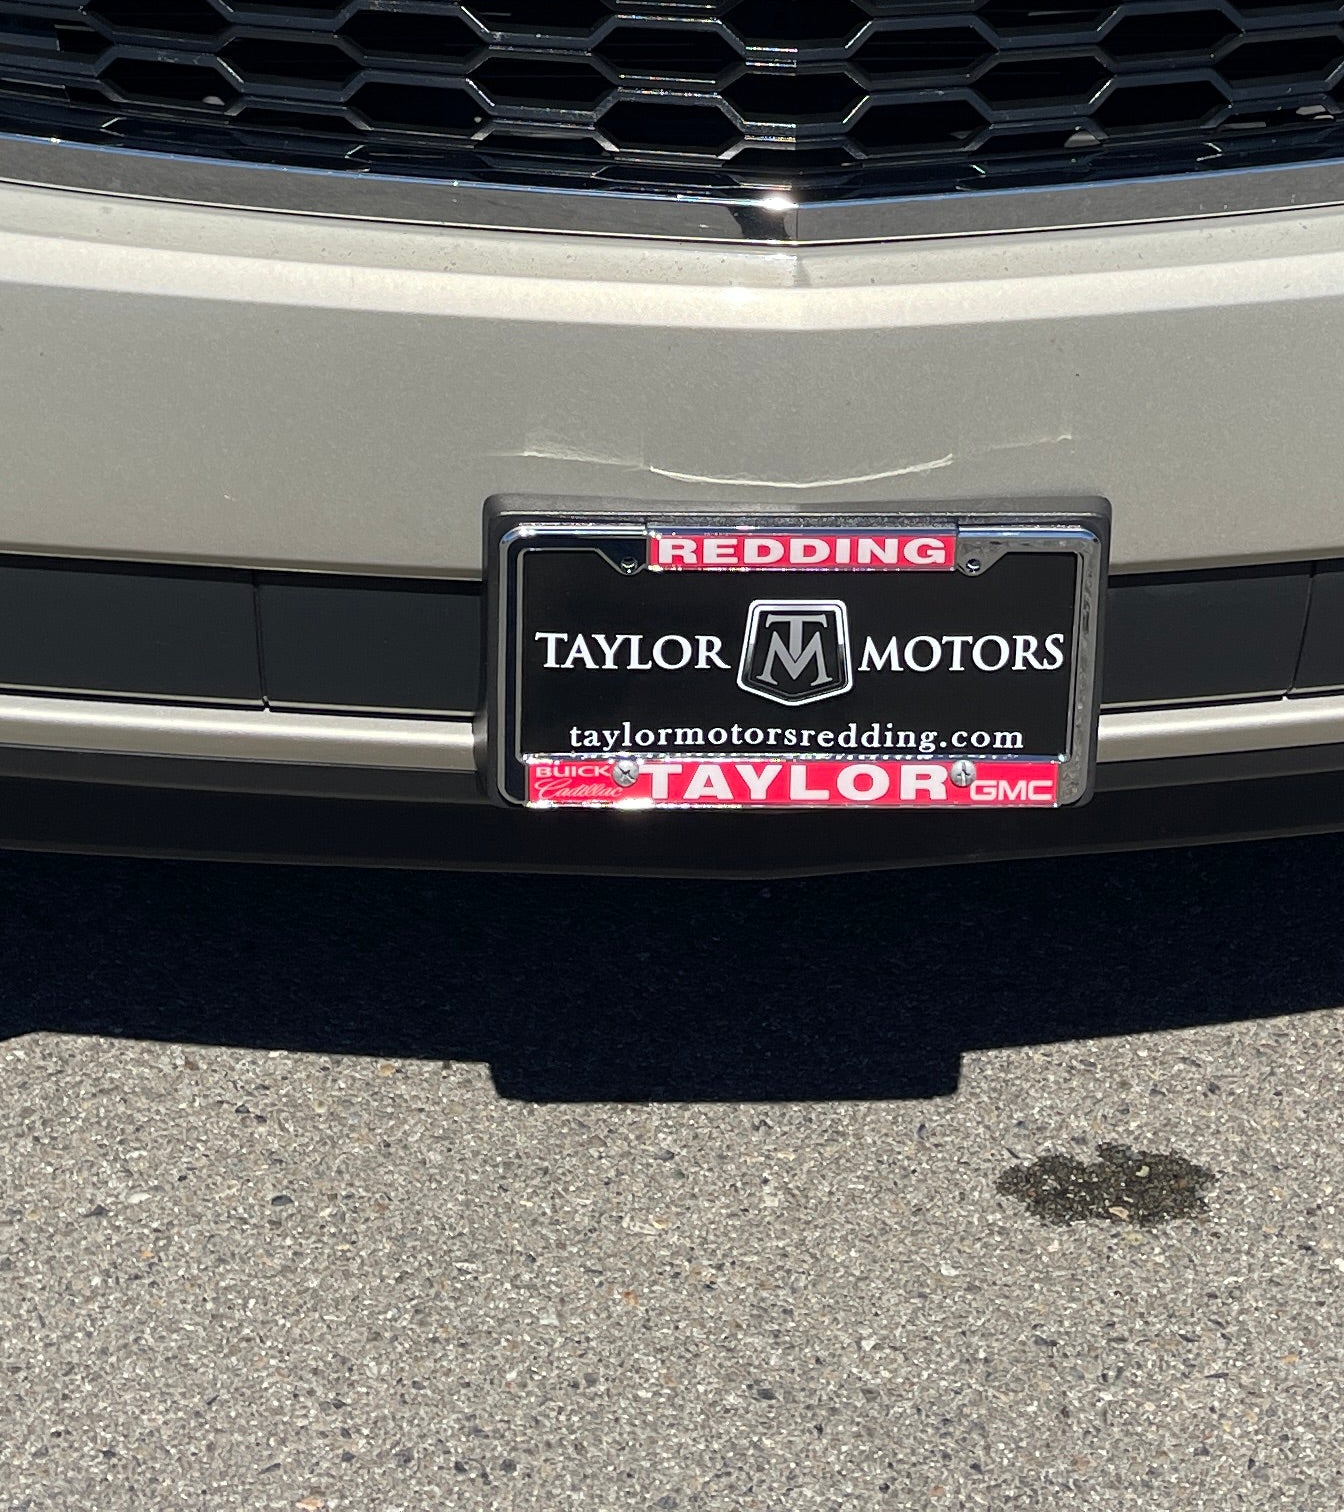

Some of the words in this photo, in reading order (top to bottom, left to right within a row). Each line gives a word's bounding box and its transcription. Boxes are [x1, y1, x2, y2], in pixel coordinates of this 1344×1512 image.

[657, 537, 947, 566] REDDING
[534, 631, 732, 671] TAYLOR
[857, 633, 1065, 672] MOTORS
[569, 721, 1025, 751] taylormotorsredding.com
[535, 765, 611, 778] BUICK
[636, 764, 954, 801] TAYLOR
[534, 777, 624, 802] Cadillac
[969, 779, 1054, 802] GMC
